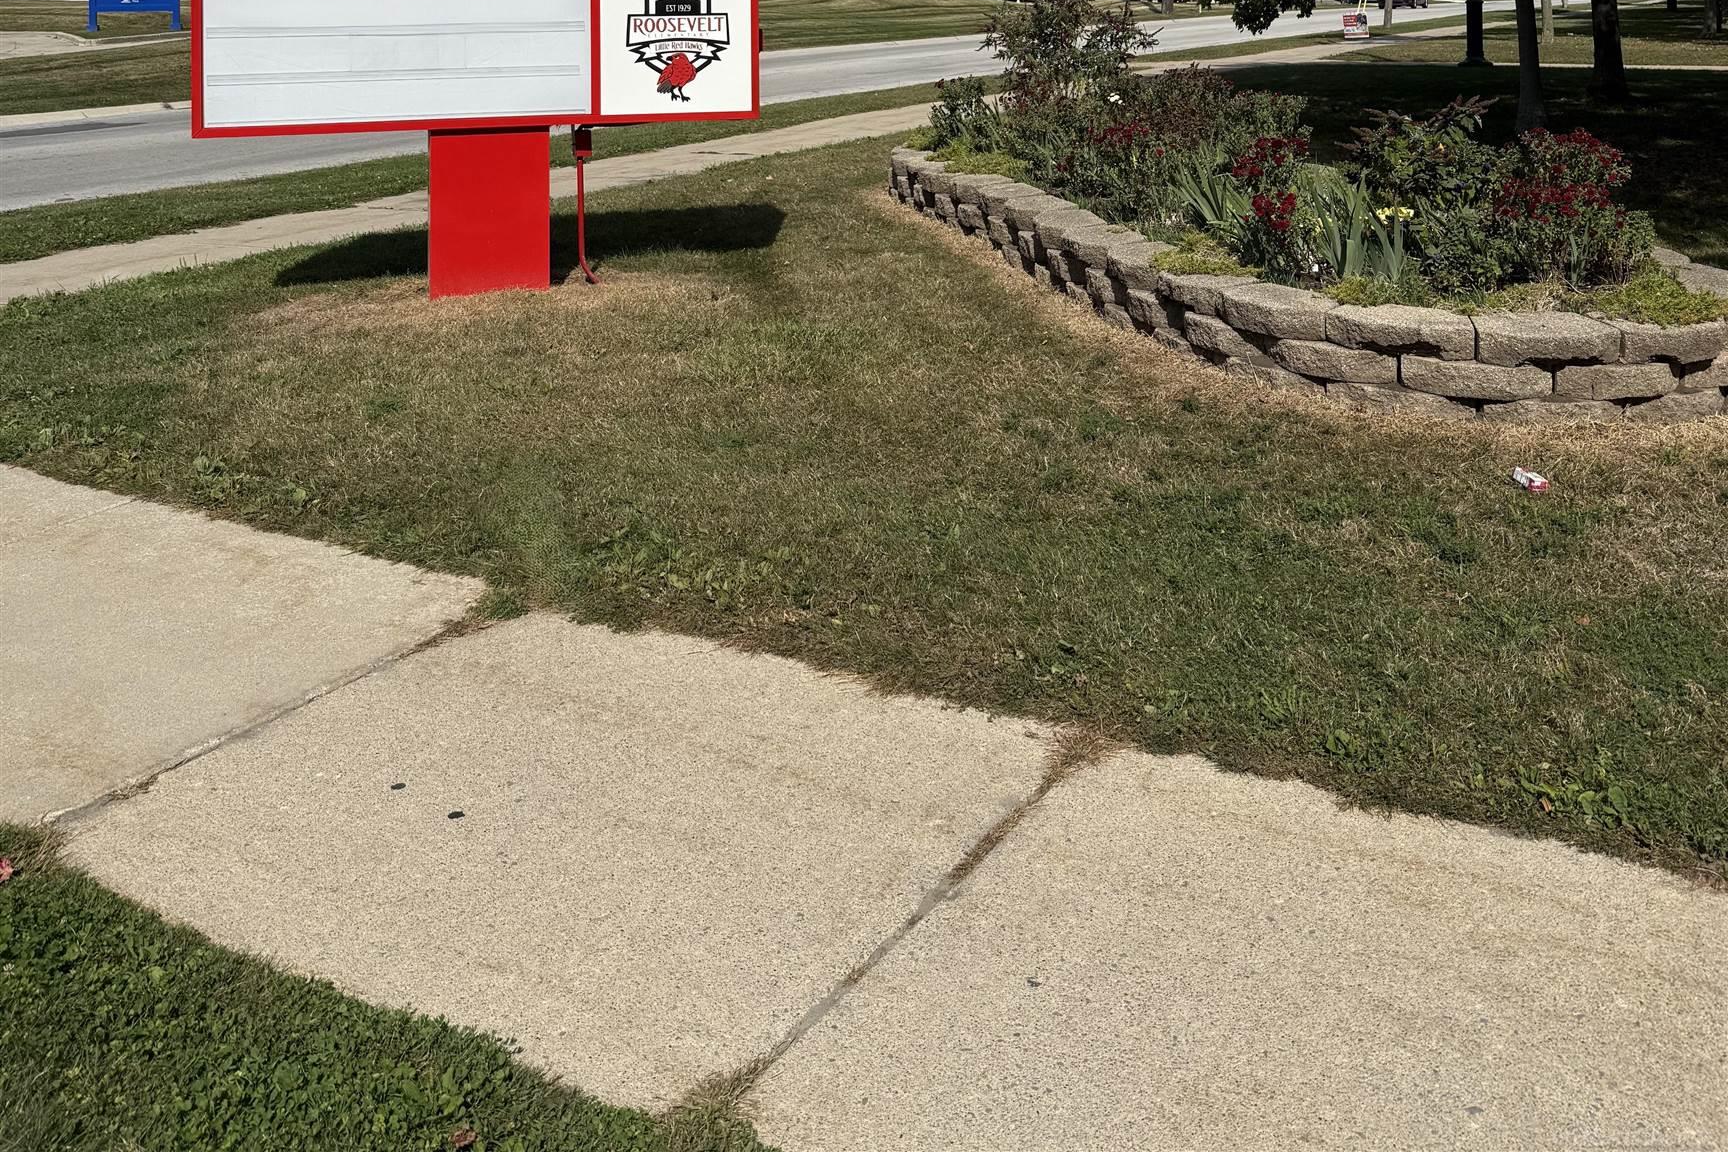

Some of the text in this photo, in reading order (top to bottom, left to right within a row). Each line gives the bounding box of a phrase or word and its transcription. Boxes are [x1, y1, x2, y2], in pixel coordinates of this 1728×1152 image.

[665, 4, 676, 12] EST
[633, 17, 724, 36] ROOSEVELT
[685, 42, 704, 51] Hawks
